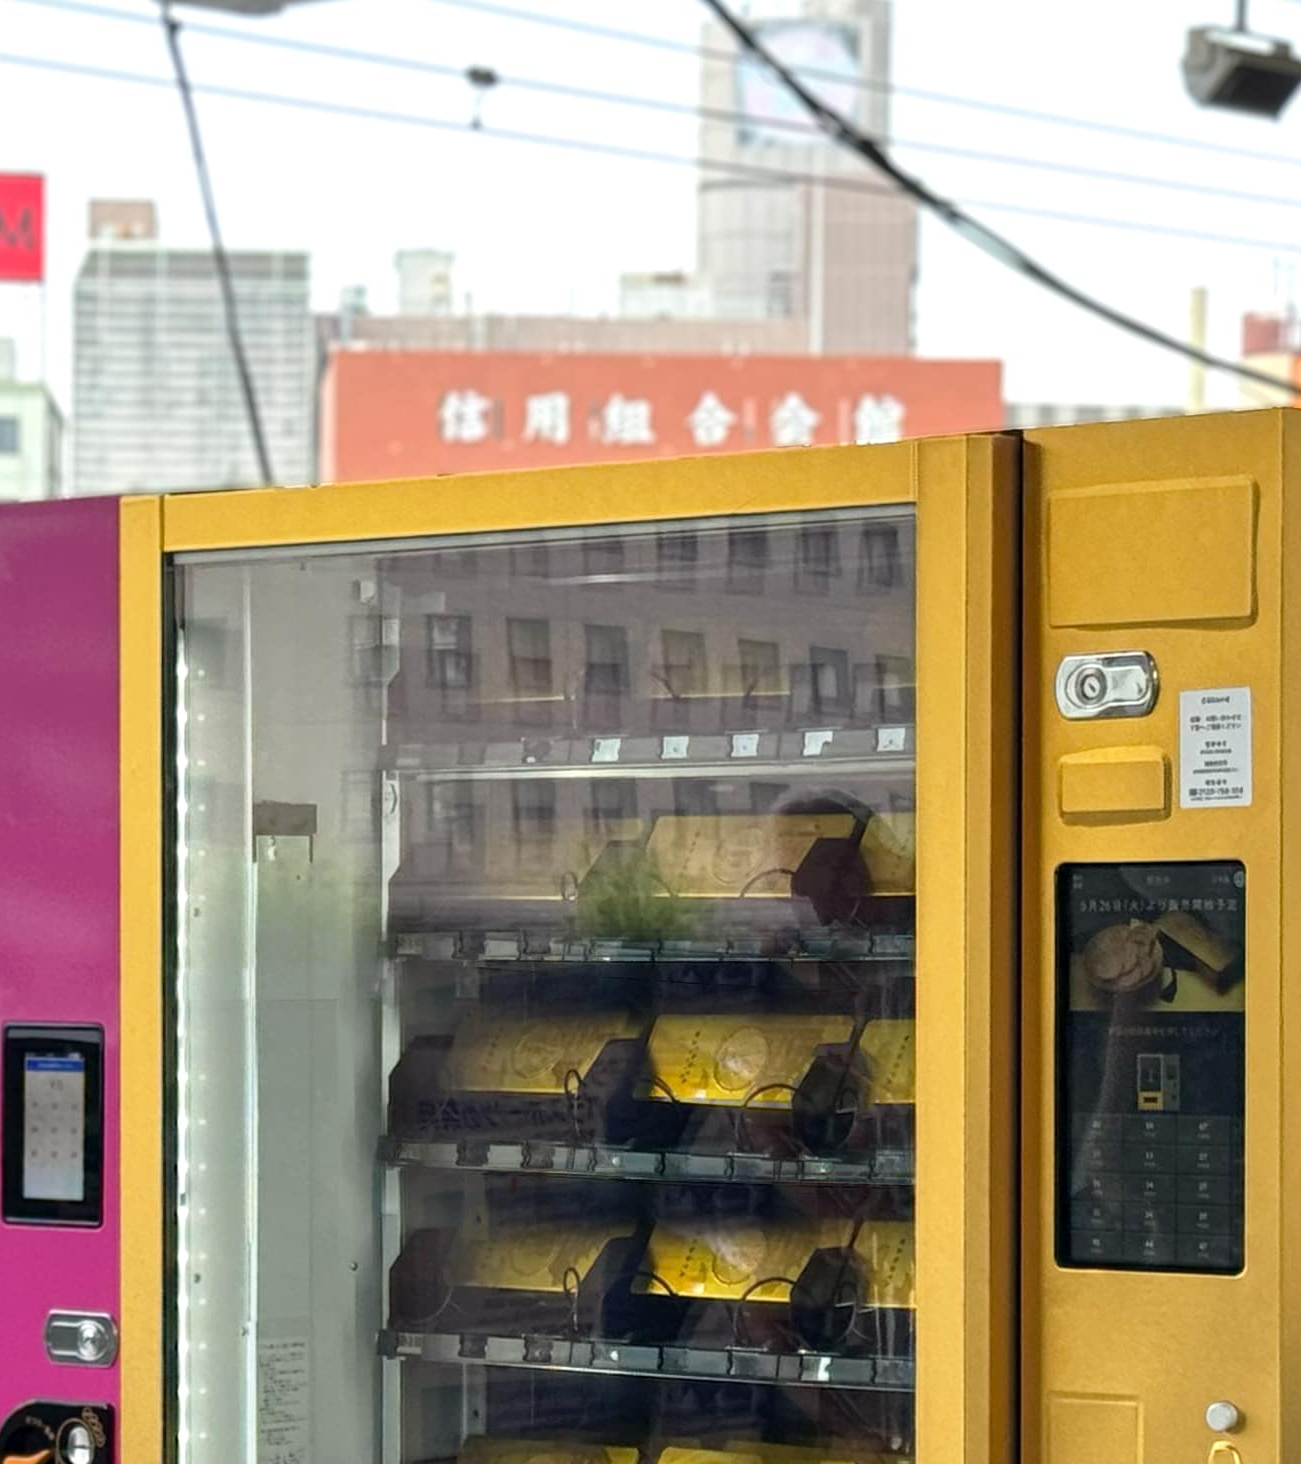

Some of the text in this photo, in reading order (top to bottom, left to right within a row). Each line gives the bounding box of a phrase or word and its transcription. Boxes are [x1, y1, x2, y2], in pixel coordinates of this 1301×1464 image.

[438, 391, 906, 447] 信用組合会館
